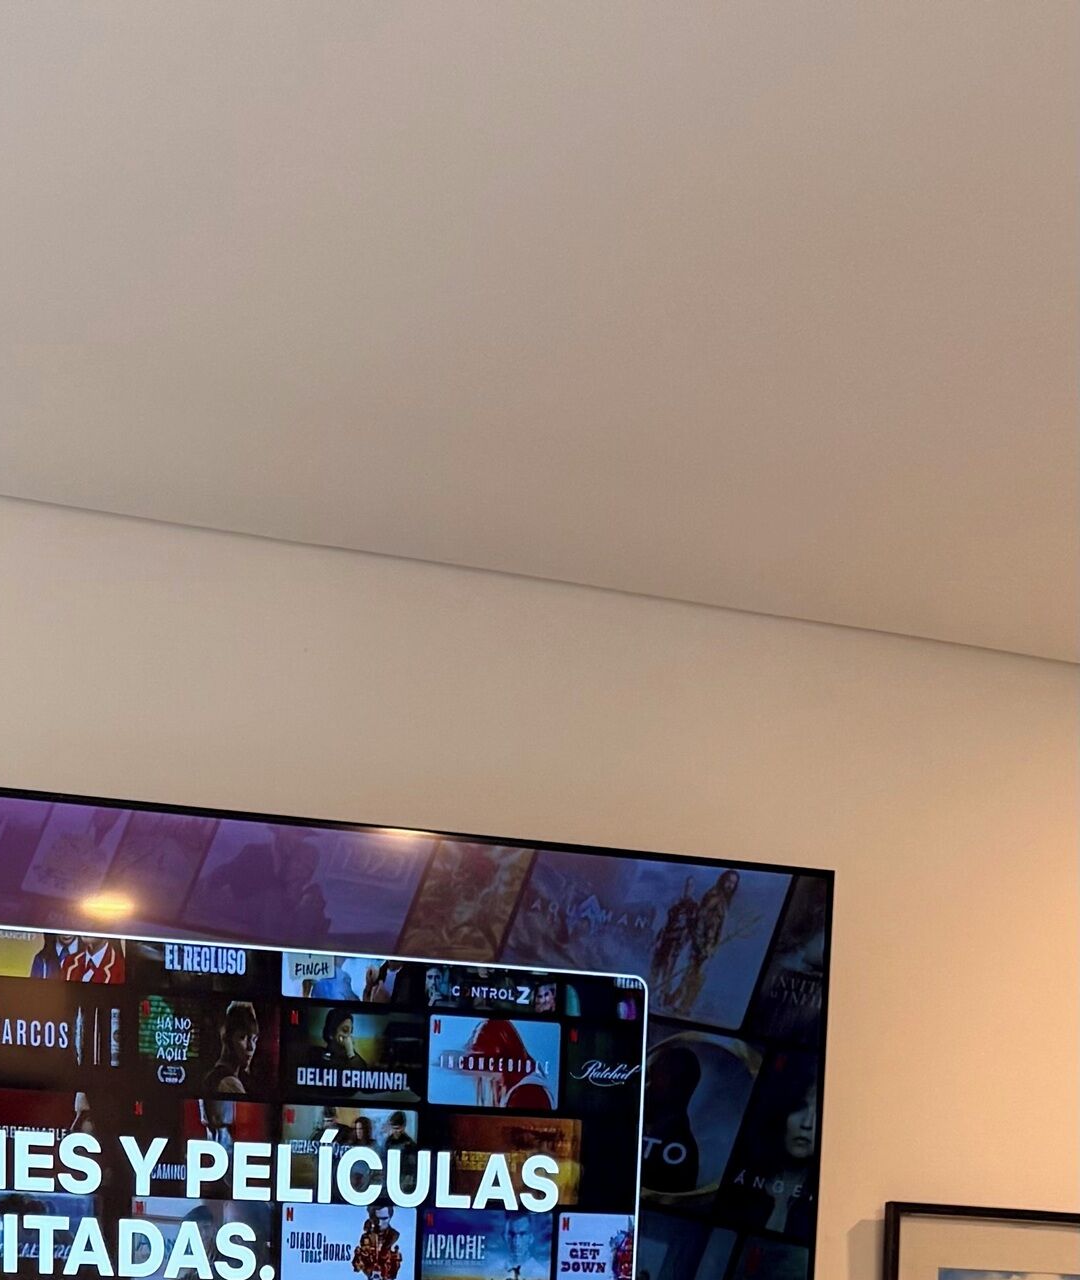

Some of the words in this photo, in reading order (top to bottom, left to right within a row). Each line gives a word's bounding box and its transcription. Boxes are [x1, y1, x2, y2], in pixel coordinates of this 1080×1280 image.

[164, 944, 181, 970] EL
[183, 946, 246, 975] RECLUSO
[294, 962, 329, 977] FINCH
[174, 1016, 191, 1030] NO
[439, 1054, 552, 1075] INCONCEBIBLE
[297, 1067, 337, 1087] DELHI
[341, 1068, 410, 1091] CRIMINAL
[119, 1135, 169, 1197] Y
[186, 1129, 560, 1213] PELÍCULAS
[290, 1231, 323, 1250] DIABLO
[426, 1234, 486, 1260] APACHE
[323, 1243, 352, 1262] HORAS
[570, 1249, 600, 1260] GET
[561, 1261, 607, 1274] DOWN
